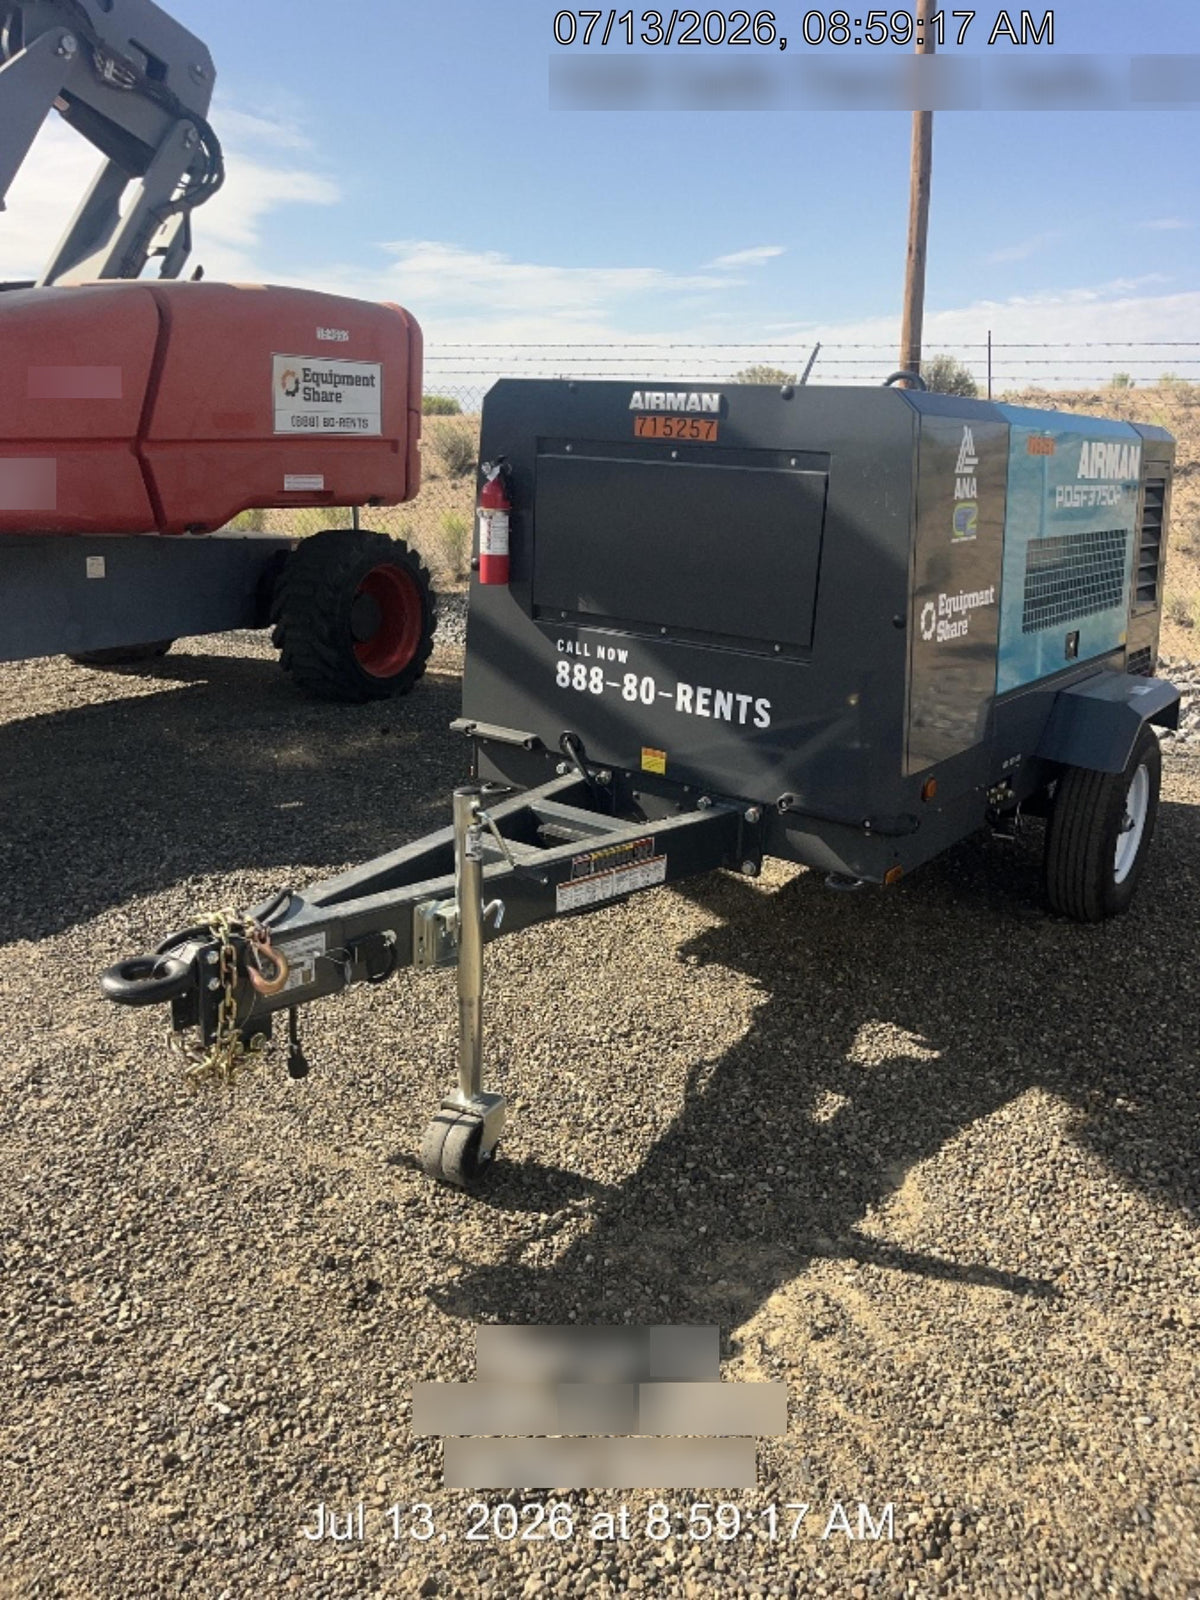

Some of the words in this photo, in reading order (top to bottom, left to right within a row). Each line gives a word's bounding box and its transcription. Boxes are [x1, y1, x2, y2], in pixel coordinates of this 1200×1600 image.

[302, 368, 376, 388] Equipment
[303, 387, 343, 404] Share
[629, 391, 720, 413] AIRMAN
[638, 417, 715, 440] 715257
[1077, 440, 1141, 480] AIRMAN
[954, 477, 978, 500] ANA
[937, 585, 995, 617] Equipment
[936, 618, 969, 643] Share
[556, 639, 591, 657] CALL
[596, 645, 629, 664] NOW
[556, 660, 772, 728] 888-80-RENTS
